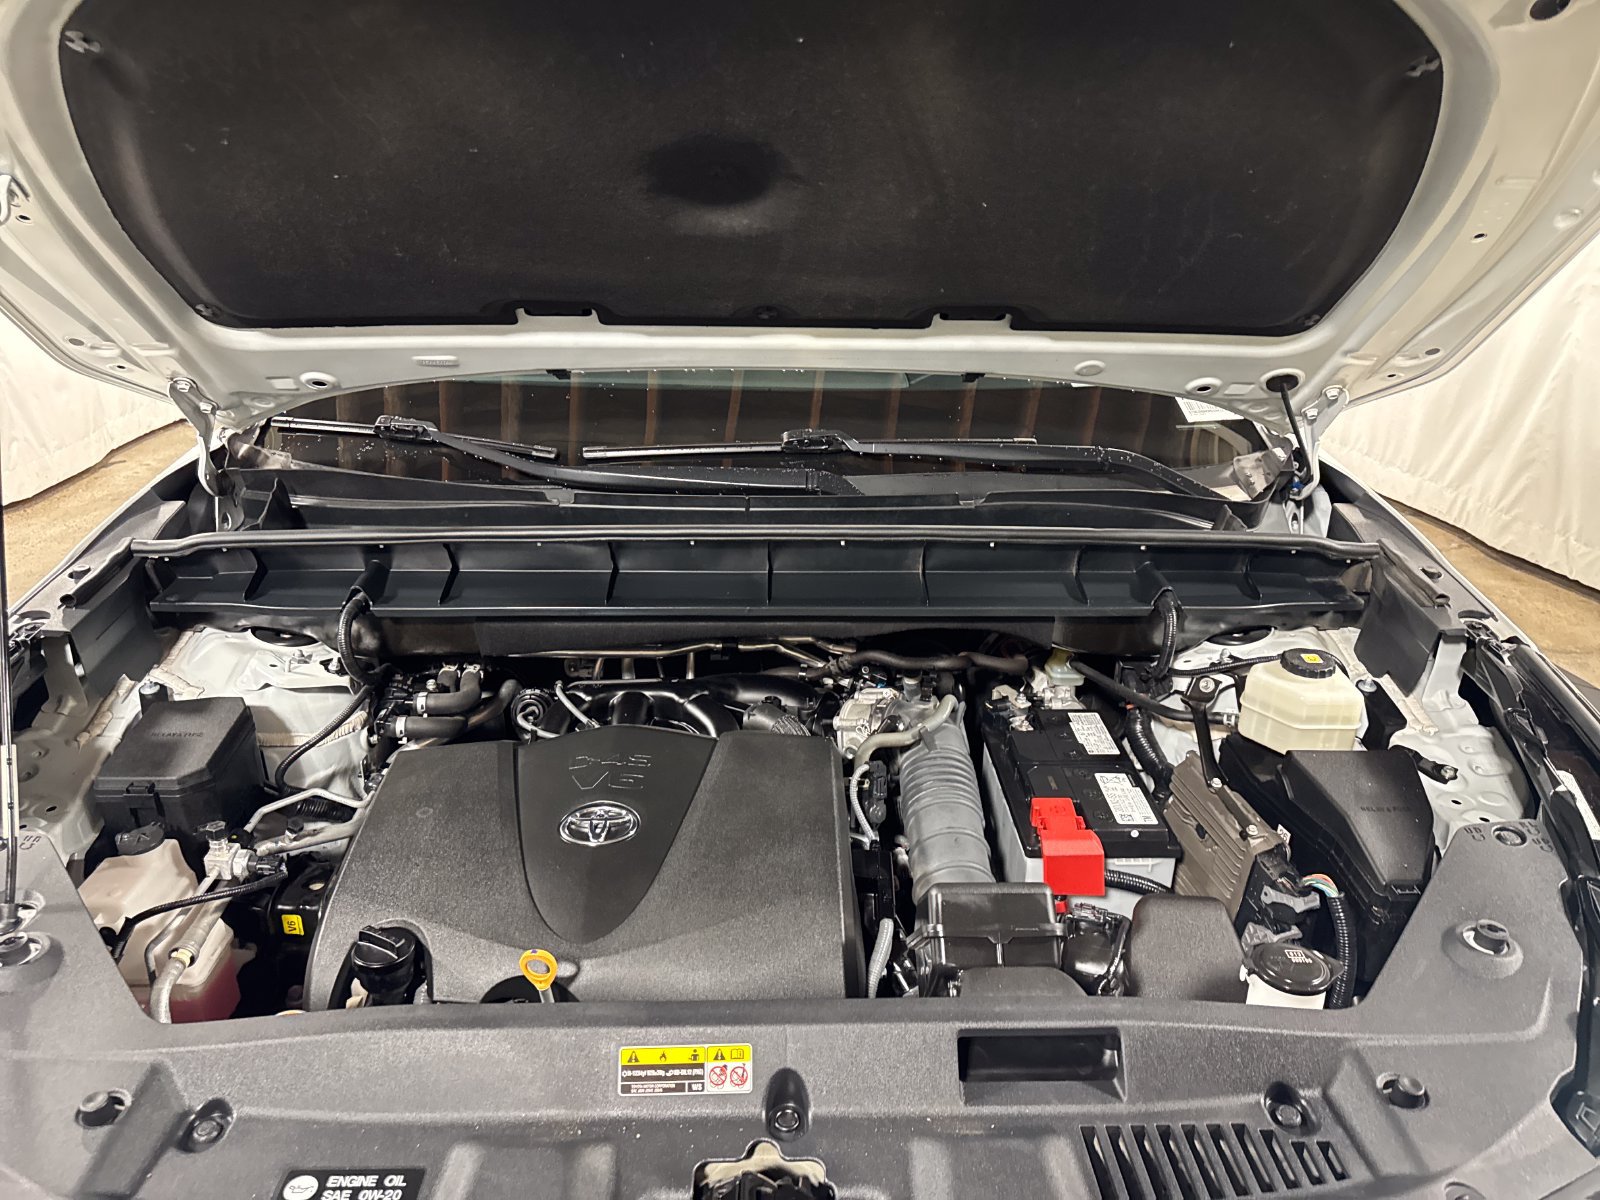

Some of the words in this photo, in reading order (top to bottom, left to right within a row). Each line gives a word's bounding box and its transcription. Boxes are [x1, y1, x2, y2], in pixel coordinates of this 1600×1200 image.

[286, 920, 297, 932] V6
[326, 1175, 379, 1188] ENGINE
[384, 1174, 407, 1187] OIL
[320, 1189, 353, 1200] SAE
[357, 1189, 403, 1200] 0W-20
